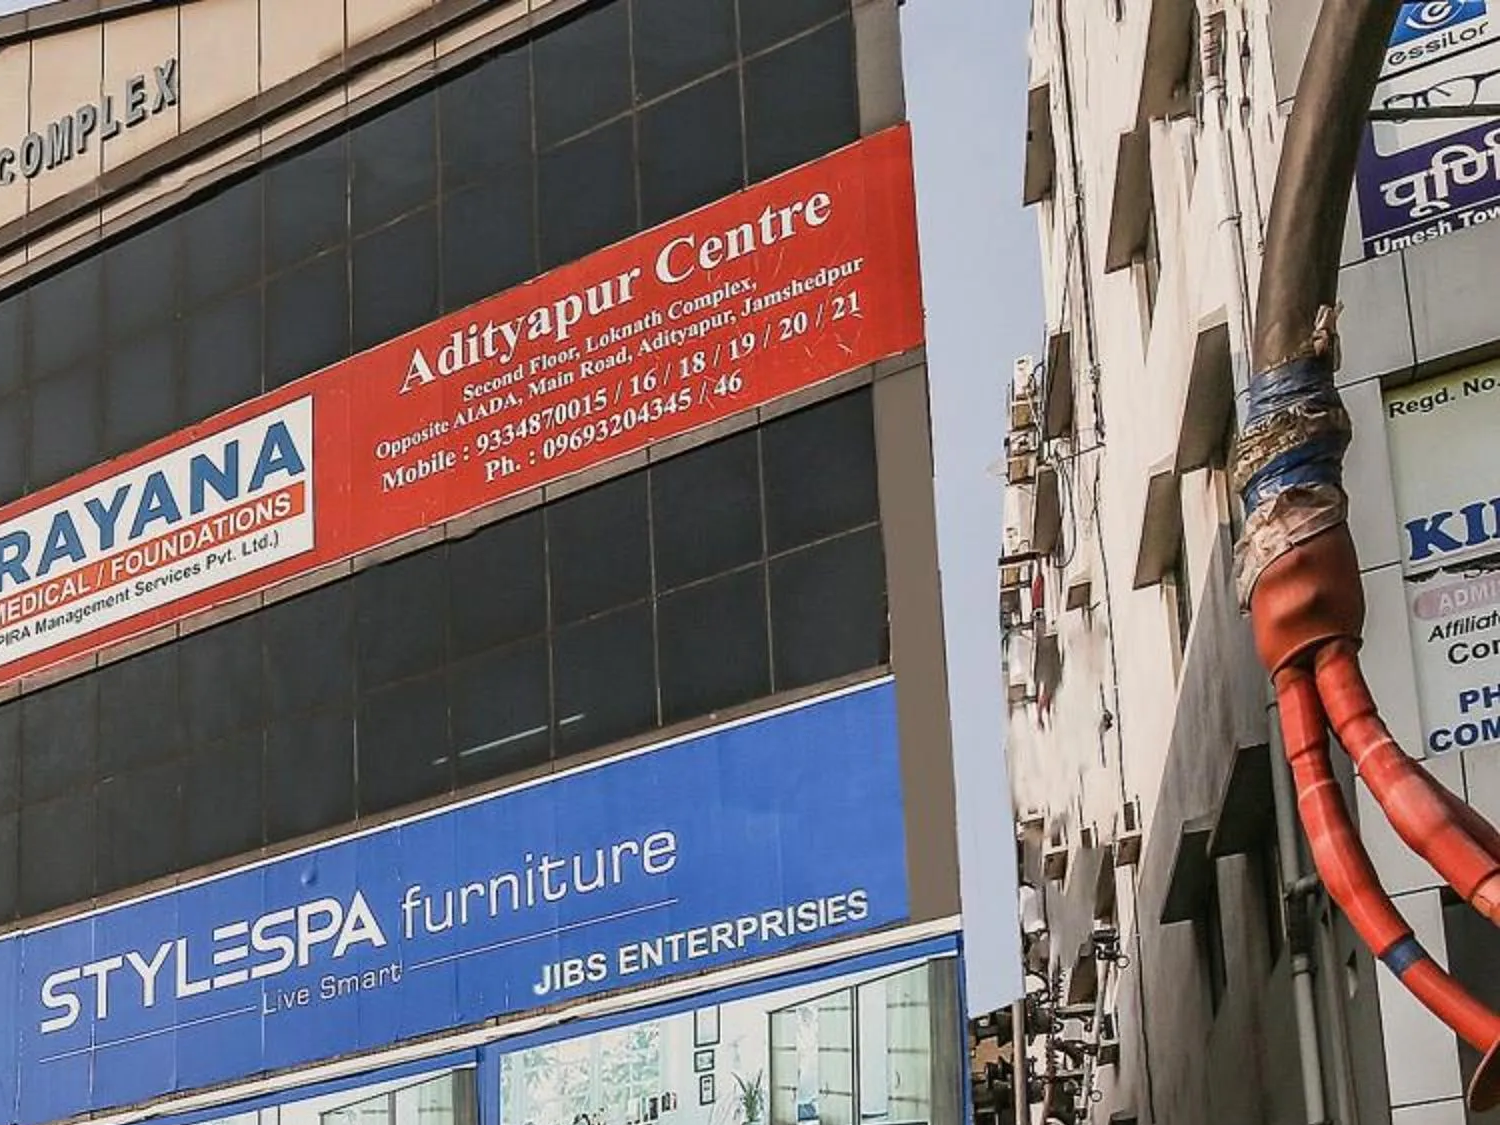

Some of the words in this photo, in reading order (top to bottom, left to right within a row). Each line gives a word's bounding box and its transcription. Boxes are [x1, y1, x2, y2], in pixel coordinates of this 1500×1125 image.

[400, 265, 640, 395] Adityapur
[655, 190, 832, 284] Centre
[1373, 220, 1452, 255] Umesh
[375, 421, 449, 460] Opposite
[528, 372, 574, 398] Main
[580, 347, 633, 378] Road,
[638, 309, 737, 356] Adityapur,
[741, 257, 864, 316] Jamshedpur
[381, 450, 457, 492] Mobile
[476, 389, 607, 456] 9334870015
[630, 368, 657, 396] 16
[680, 351, 706, 379] 18
[729, 334, 756, 361] 19
[779, 311, 807, 341] 20
[831, 290, 860, 321] 21
[463, 364, 524, 401] Second
[529, 346, 580, 375] Floor,
[585, 309, 662, 352] Loknath
[668, 276, 757, 320] Complex,
[485, 457, 521, 484] Ph.
[542, 387, 691, 460] 09693204345
[713, 370, 742, 396] 46
[1389, 387, 1455, 418] Regd.
[35, 590, 131, 640] Management
[134, 562, 201, 594] Services
[205, 546, 237, 571] Pvt.
[241, 528, 280, 558] Ltd.)
[110, 495, 291, 582] FOUNDATIONS
[1428, 610, 1500, 642] Affiliat
[1440, 581, 1500, 615] ADMI
[39, 888, 388, 1035] STYLESPA
[400, 827, 678, 940] furniture
[533, 955, 609, 997] JIBS
[618, 888, 870, 978] ENTERPRISIES
[262, 983, 311, 1017] Live
[318, 960, 401, 999] Smart
